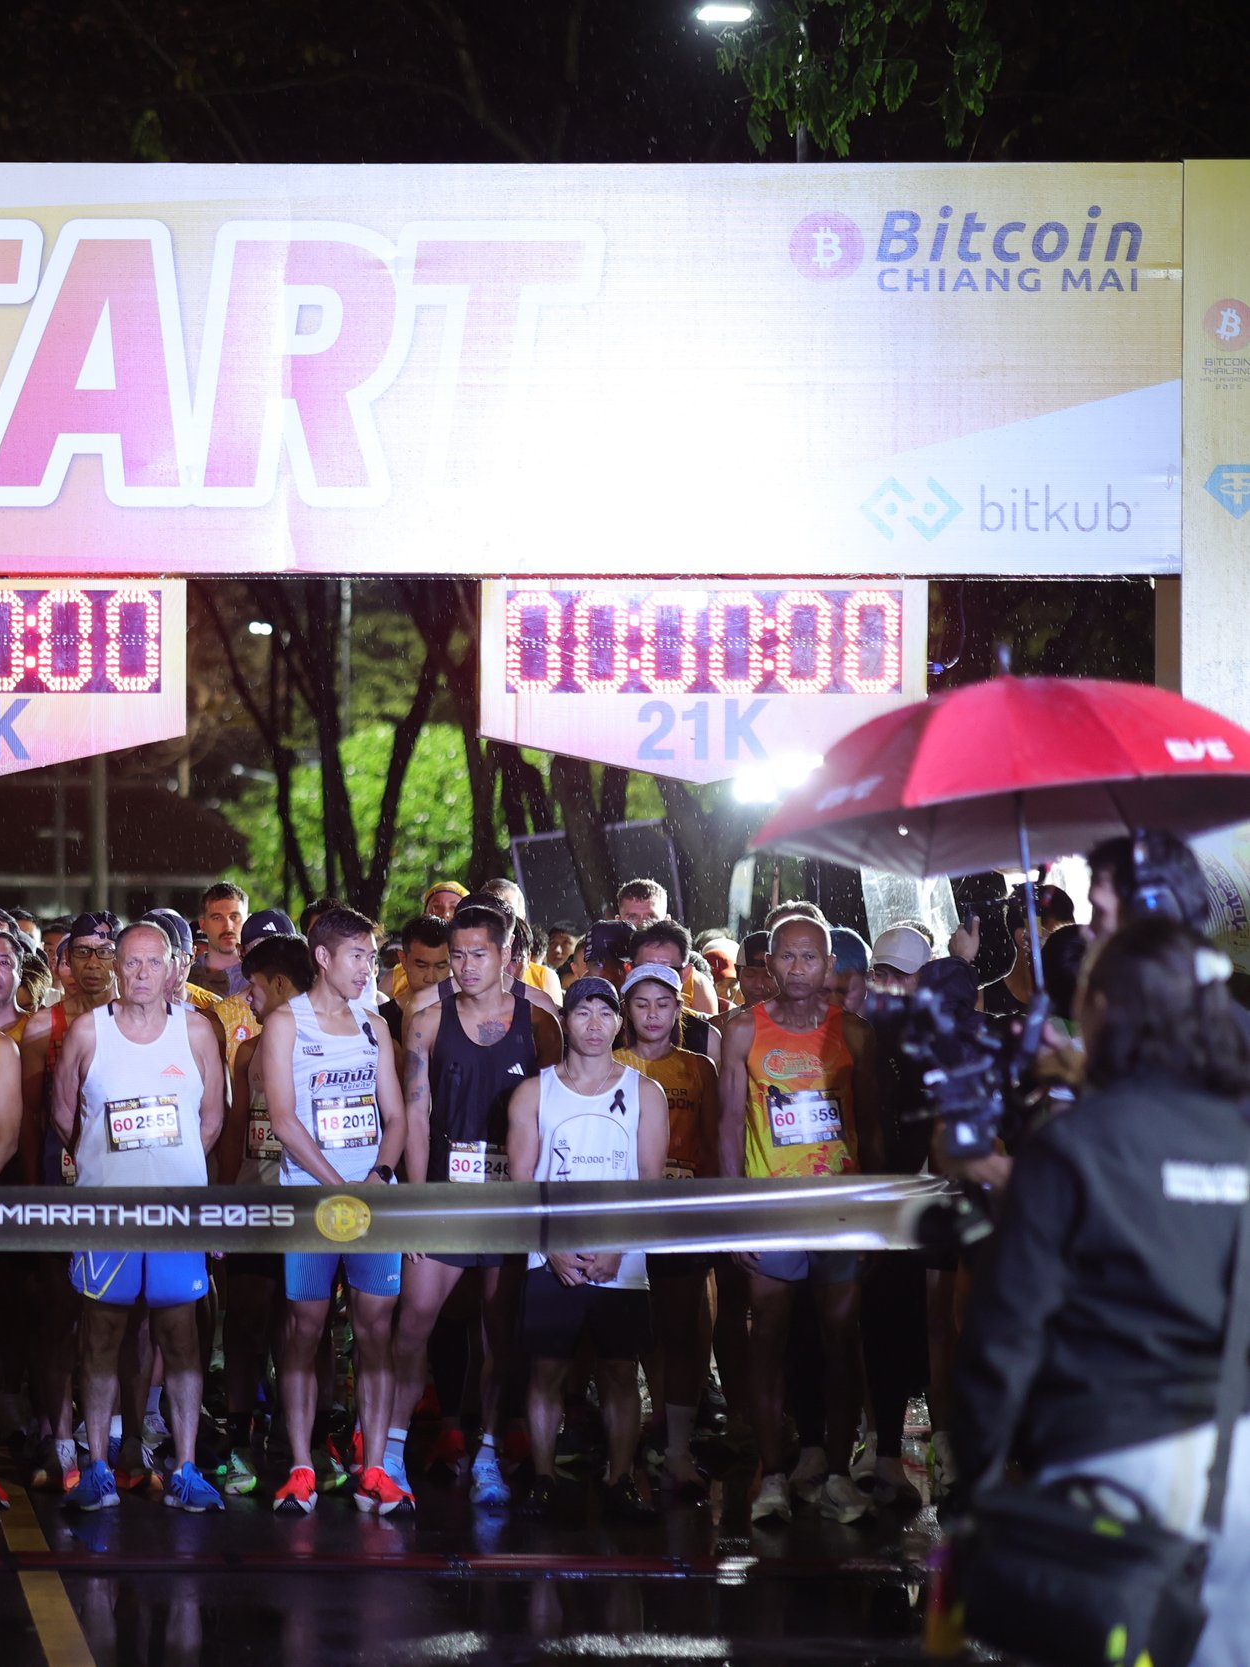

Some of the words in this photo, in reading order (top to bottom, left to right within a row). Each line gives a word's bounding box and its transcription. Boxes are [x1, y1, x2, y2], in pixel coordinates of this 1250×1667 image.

[875, 205, 1143, 263] Bitcoin
[877, 267, 1042, 292] CHIANG
[1061, 267, 1138, 292] MAI
[980, 484, 1132, 532] bitkub
[506, 590, 901, 694] 00:00:00
[636, 698, 770, 762] 21K
[199, 1203, 296, 1228] 2025
